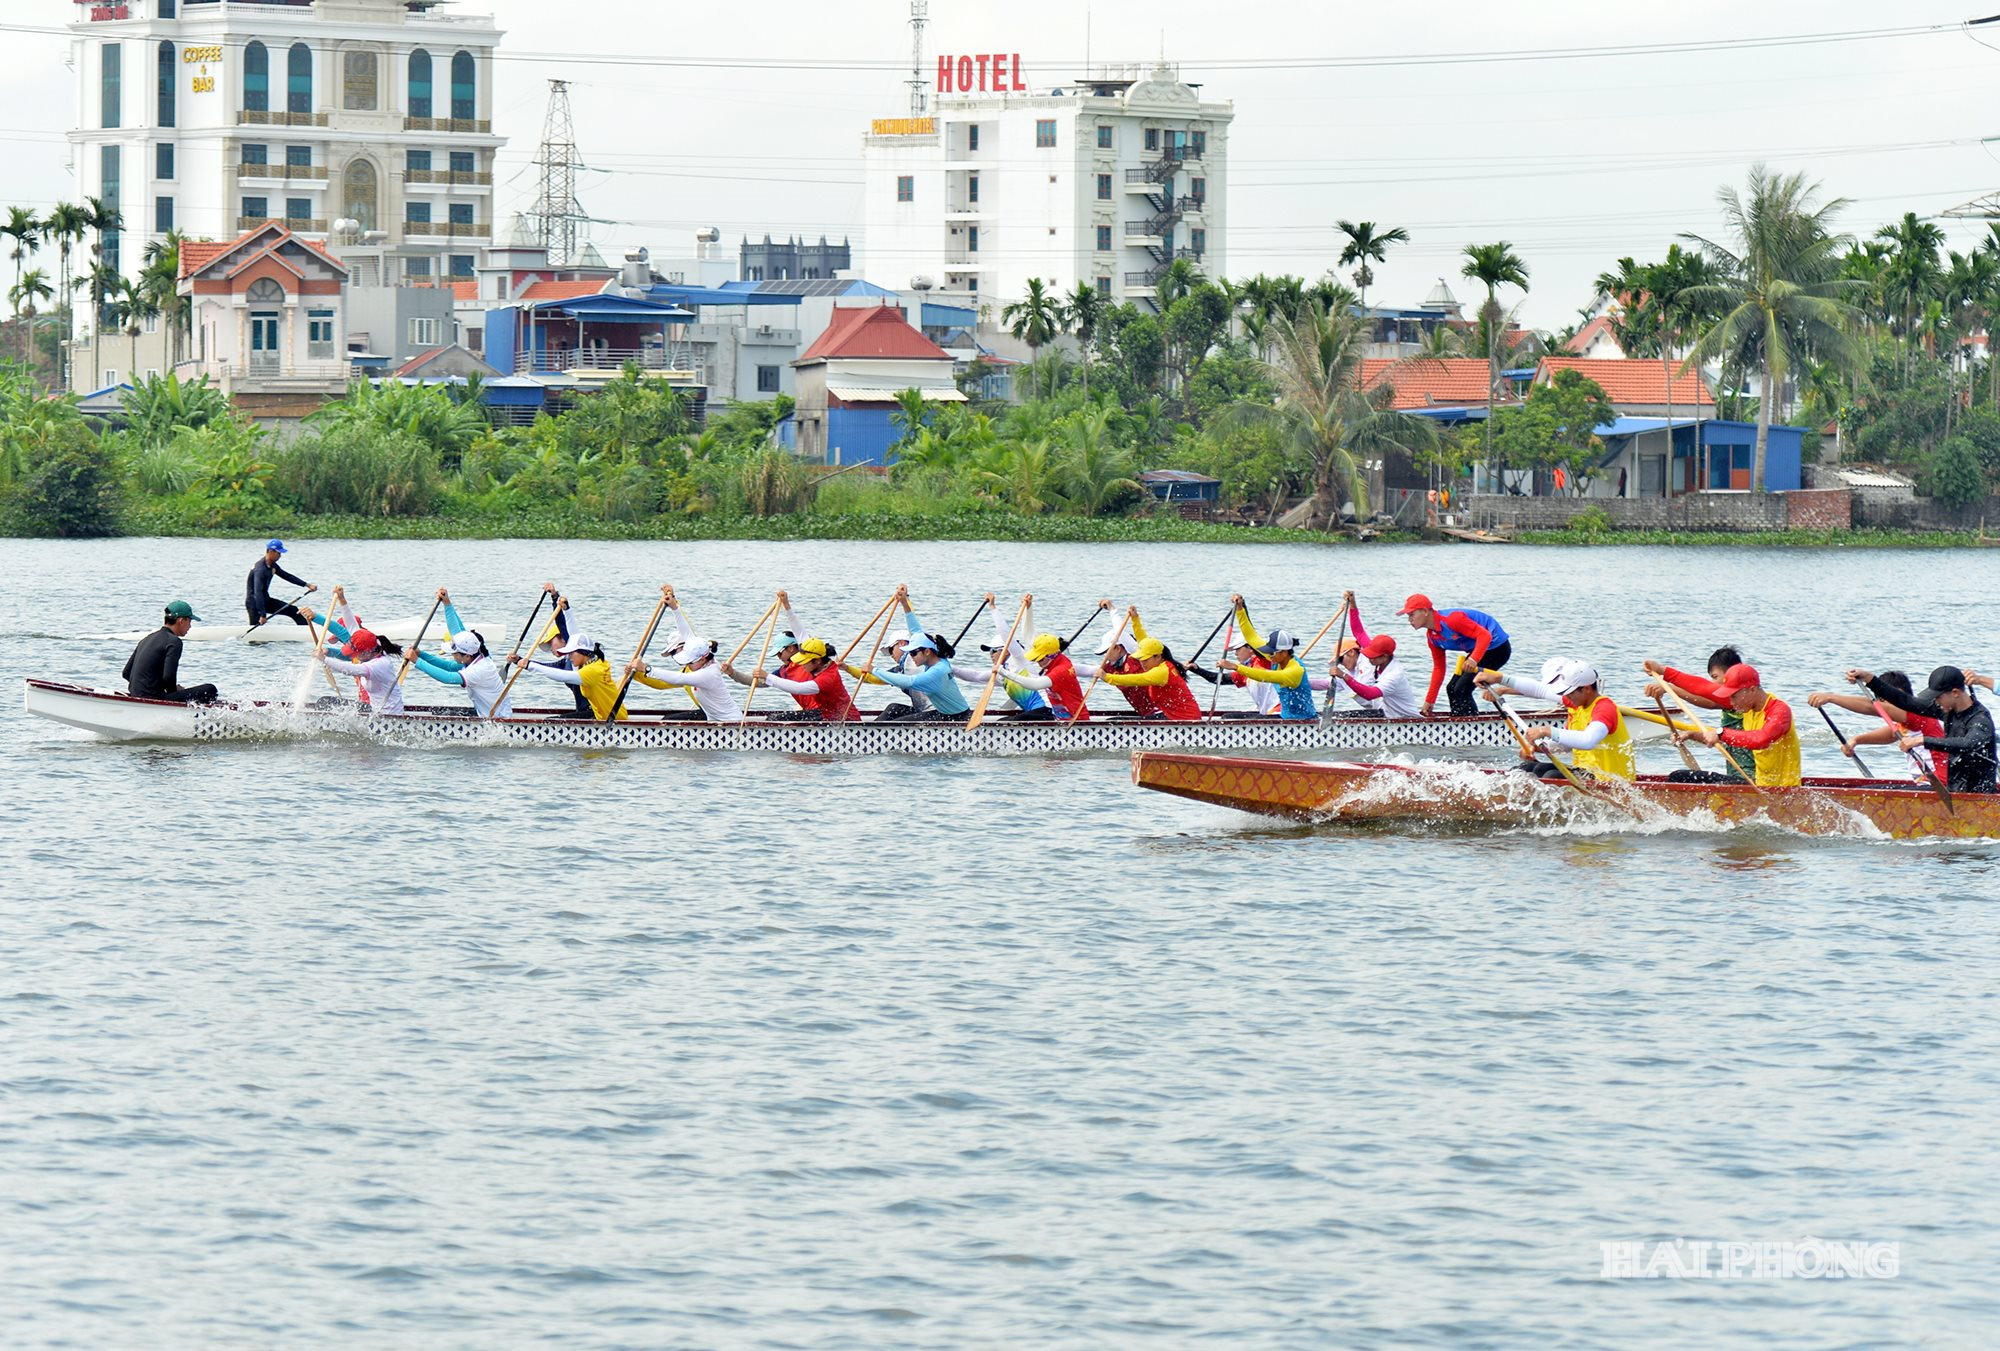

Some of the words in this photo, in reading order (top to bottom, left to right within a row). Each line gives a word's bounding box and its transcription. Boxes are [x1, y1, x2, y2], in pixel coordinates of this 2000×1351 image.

[183, 47, 223, 63] COFFEE
[937, 53, 1026, 93] HOTEL
[192, 77, 215, 93] BAR
